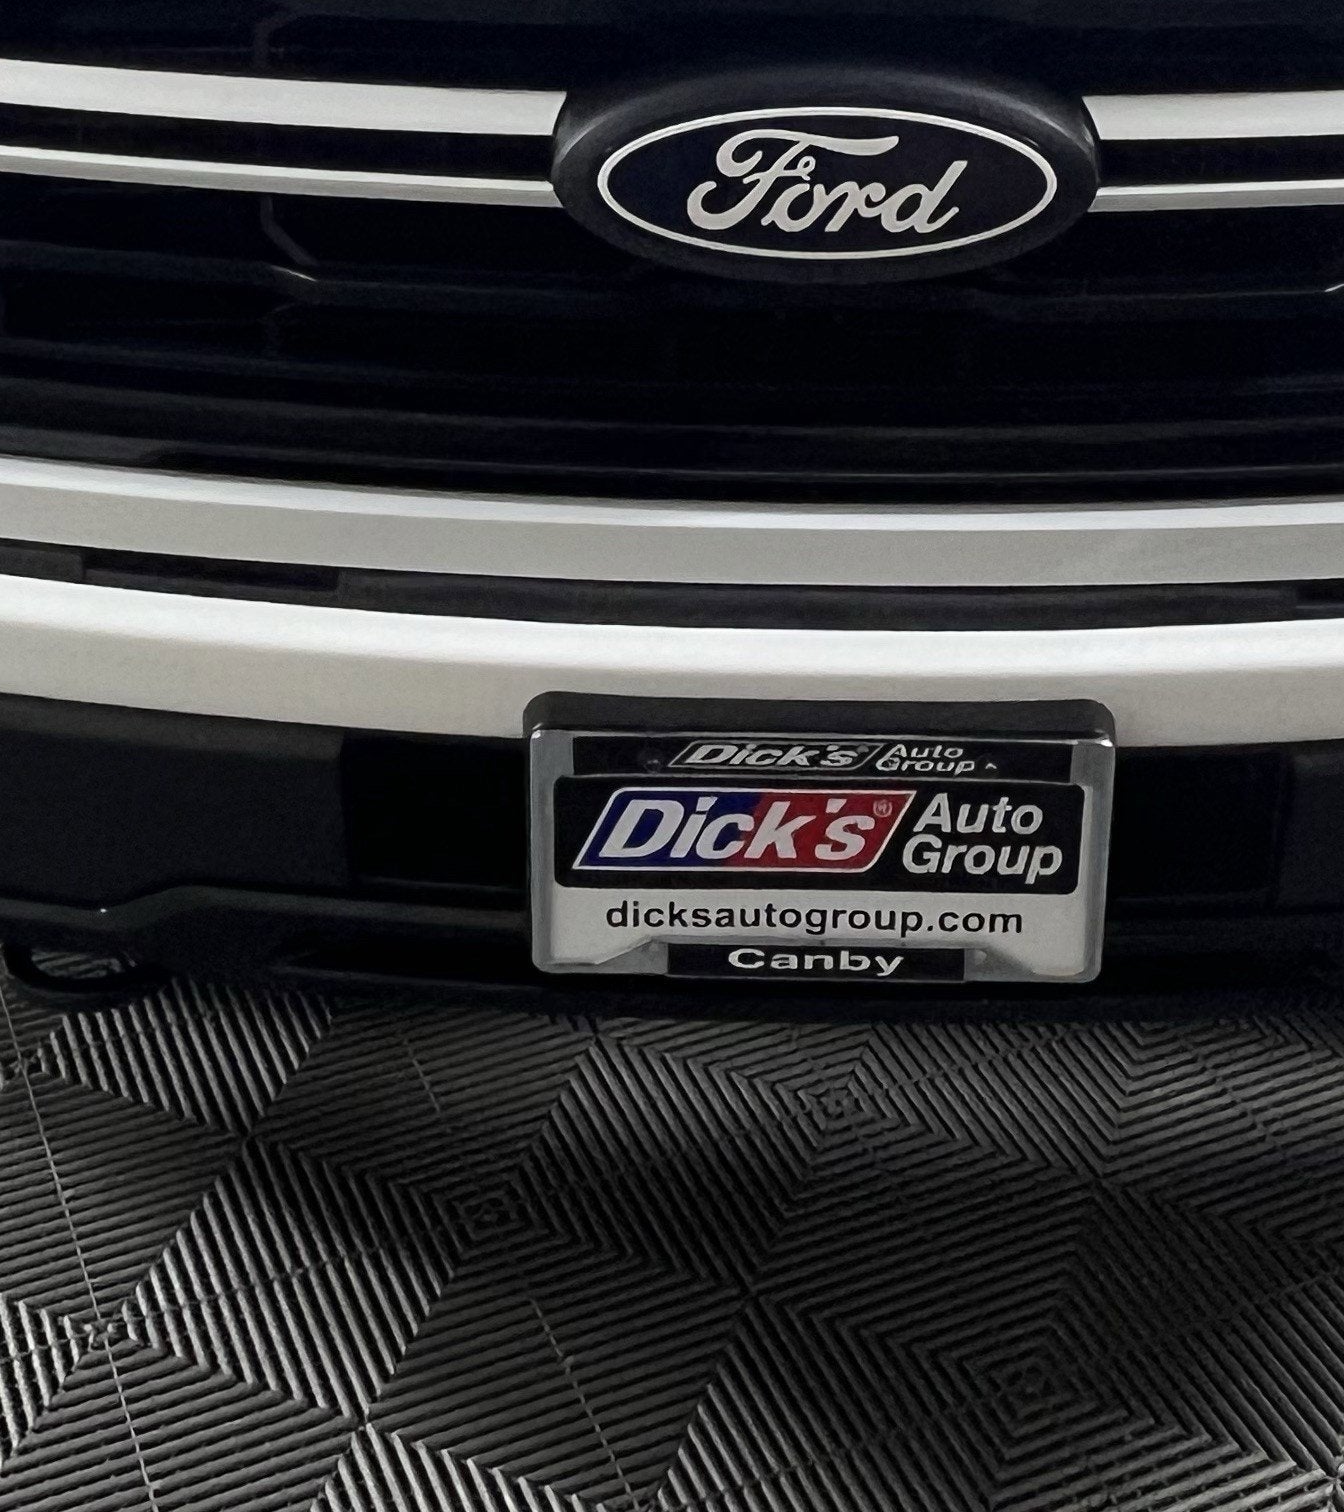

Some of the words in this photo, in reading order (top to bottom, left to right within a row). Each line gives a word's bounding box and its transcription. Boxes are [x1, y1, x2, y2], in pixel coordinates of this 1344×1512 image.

[687, 128, 967, 234] Ford
[685, 743, 860, 767] Dick's
[875, 758, 975, 775] Group
[889, 743, 964, 759] Auto
[598, 797, 875, 861] Dick's
[913, 792, 1044, 836] Auto
[902, 835, 1063, 884] Group
[605, 901, 1023, 937] dicksautogroup.com
[727, 948, 904, 978] Canby
